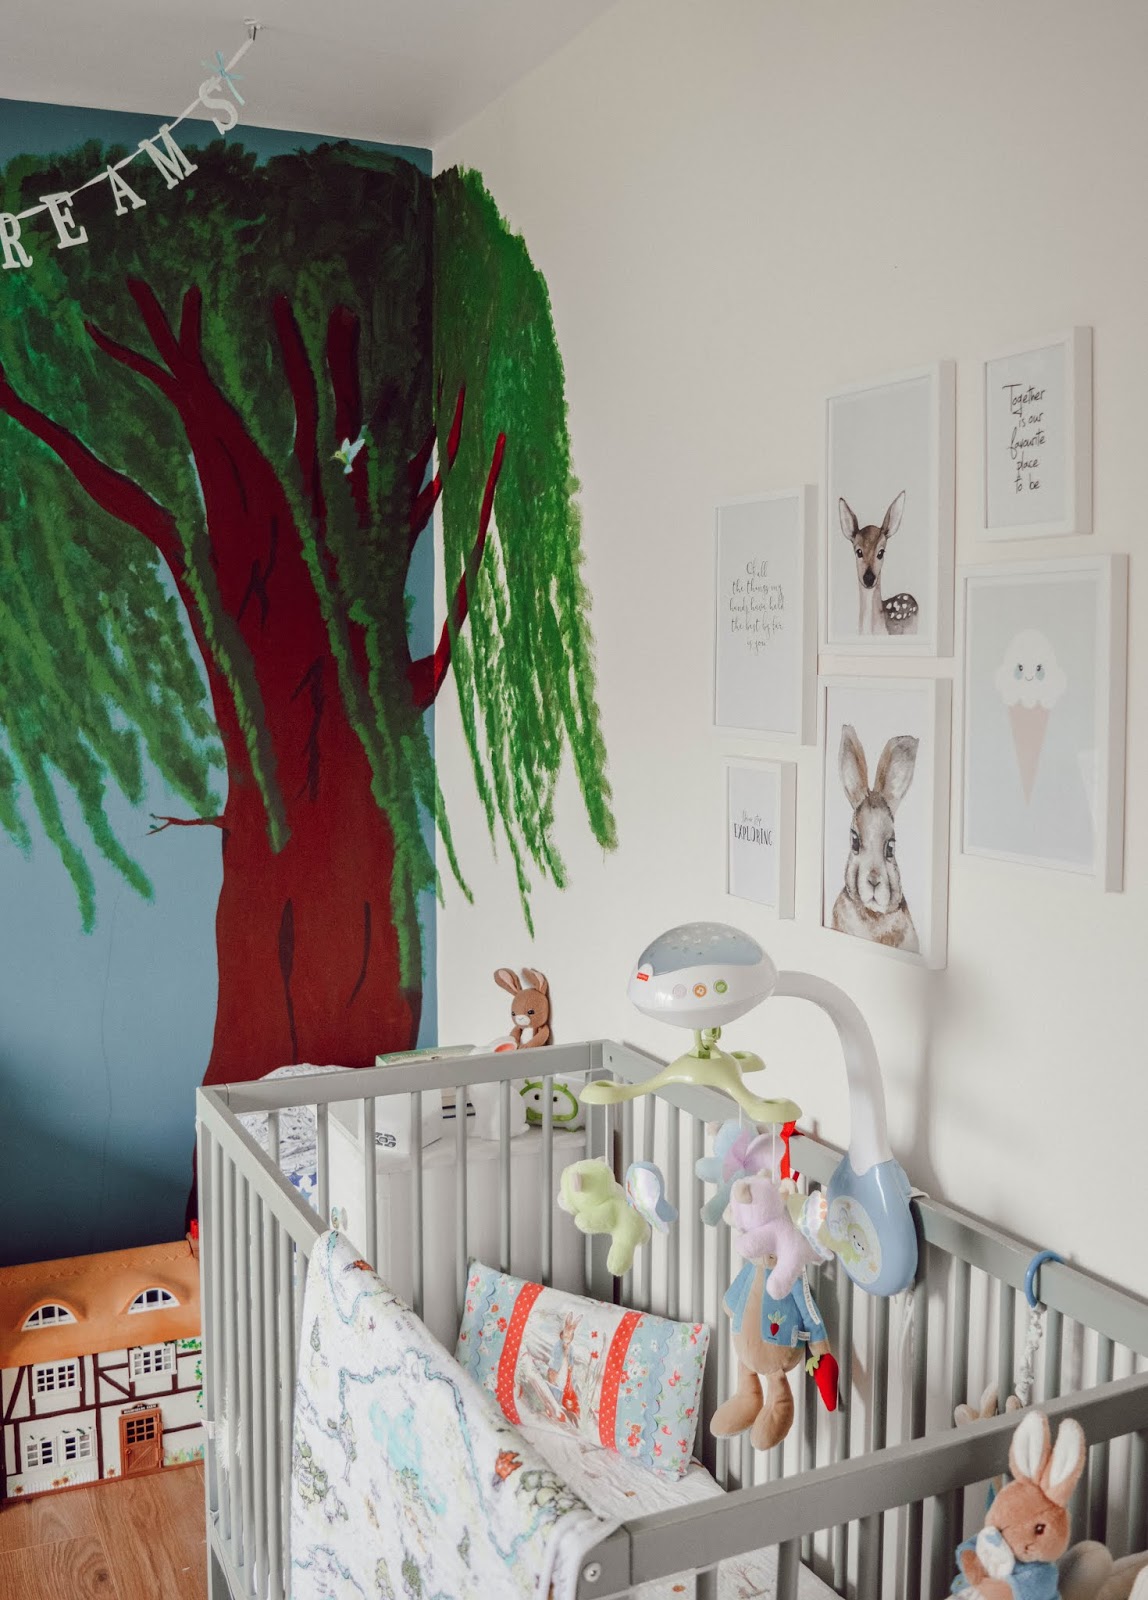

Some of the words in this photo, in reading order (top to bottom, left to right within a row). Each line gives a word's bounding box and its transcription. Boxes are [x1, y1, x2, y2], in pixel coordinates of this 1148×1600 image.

[1002, 384, 1045, 417] Together
[1018, 418, 1026, 428] is
[1028, 412, 1044, 424] our
[1007, 427, 1046, 460] favourite
[1016, 452, 1040, 477] place
[1014, 476, 1023, 494] to
[1029, 473, 1040, 490] be
[732, 578, 745, 595] the
[734, 823, 773, 846] EXPLORING
